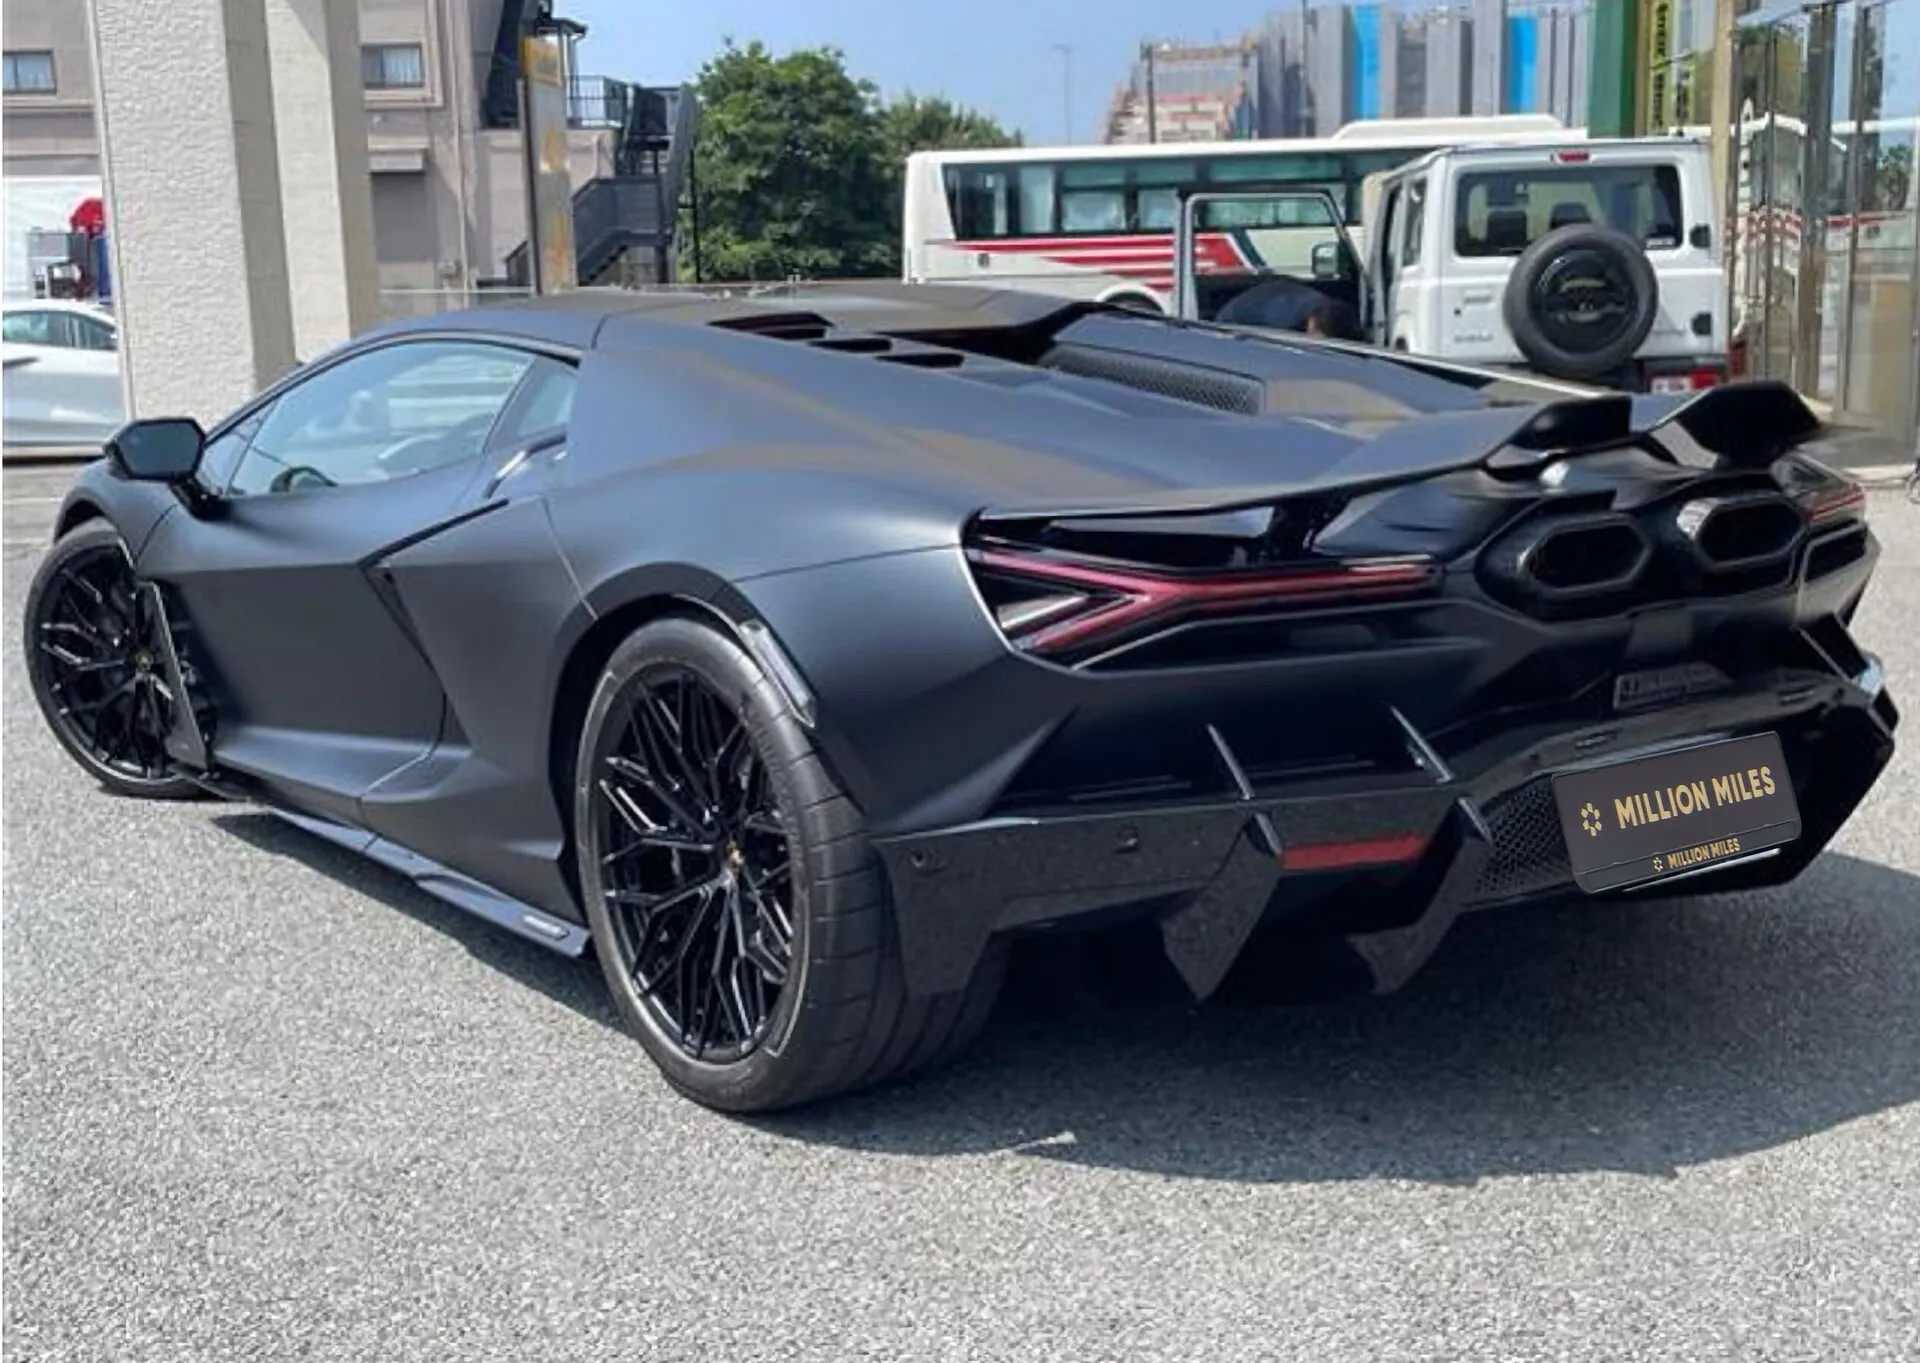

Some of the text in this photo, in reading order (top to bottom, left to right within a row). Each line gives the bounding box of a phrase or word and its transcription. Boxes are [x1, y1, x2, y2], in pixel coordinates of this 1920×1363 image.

[1614, 766, 1775, 829] MILLION MILES
[1667, 838, 1740, 869] MILLION MILES
